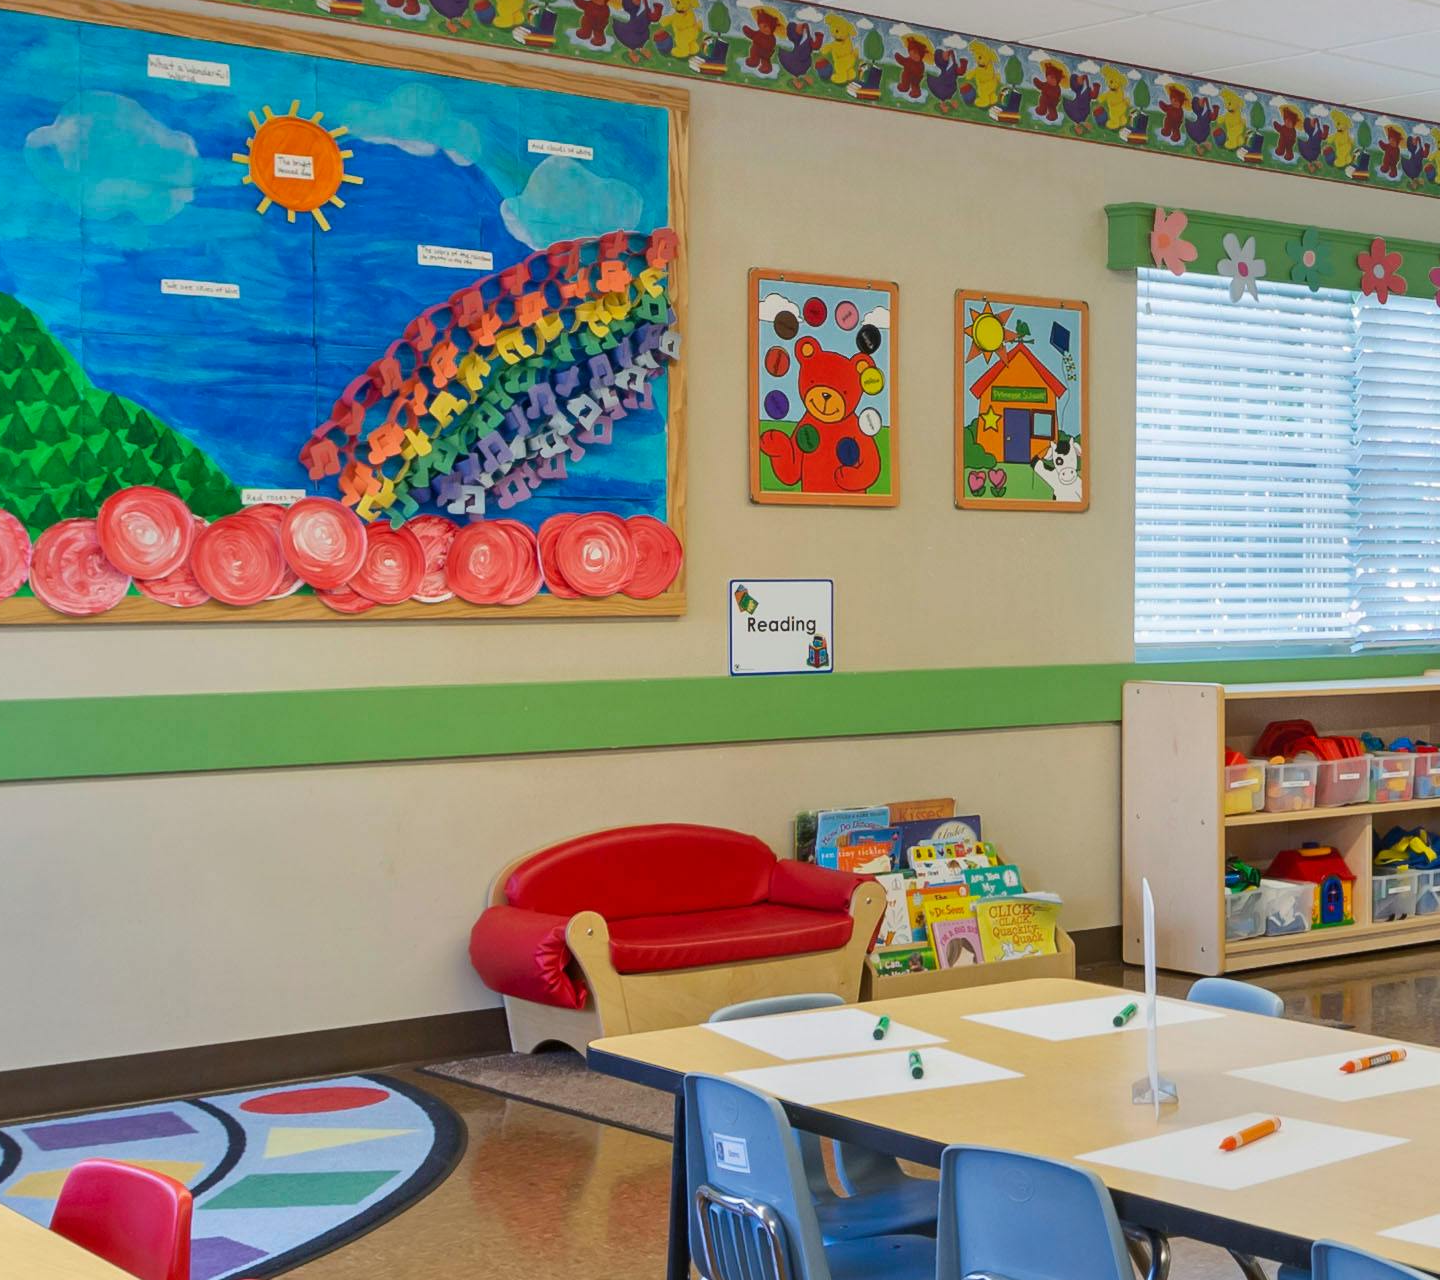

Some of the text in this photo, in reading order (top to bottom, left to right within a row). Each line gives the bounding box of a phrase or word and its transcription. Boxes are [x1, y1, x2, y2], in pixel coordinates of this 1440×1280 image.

[150, 58, 174, 70] What
[184, 63, 229, 79] Wonderful
[247, 494, 263, 502] Red
[747, 616, 816, 635] Reading
[840, 823, 851, 832] Do
[838, 850, 856, 858] tiny
[857, 845, 889, 857] tickles
[970, 872, 1001, 883] Are You
[982, 882, 996, 893] My
[988, 904, 1035, 919] CLICK,
